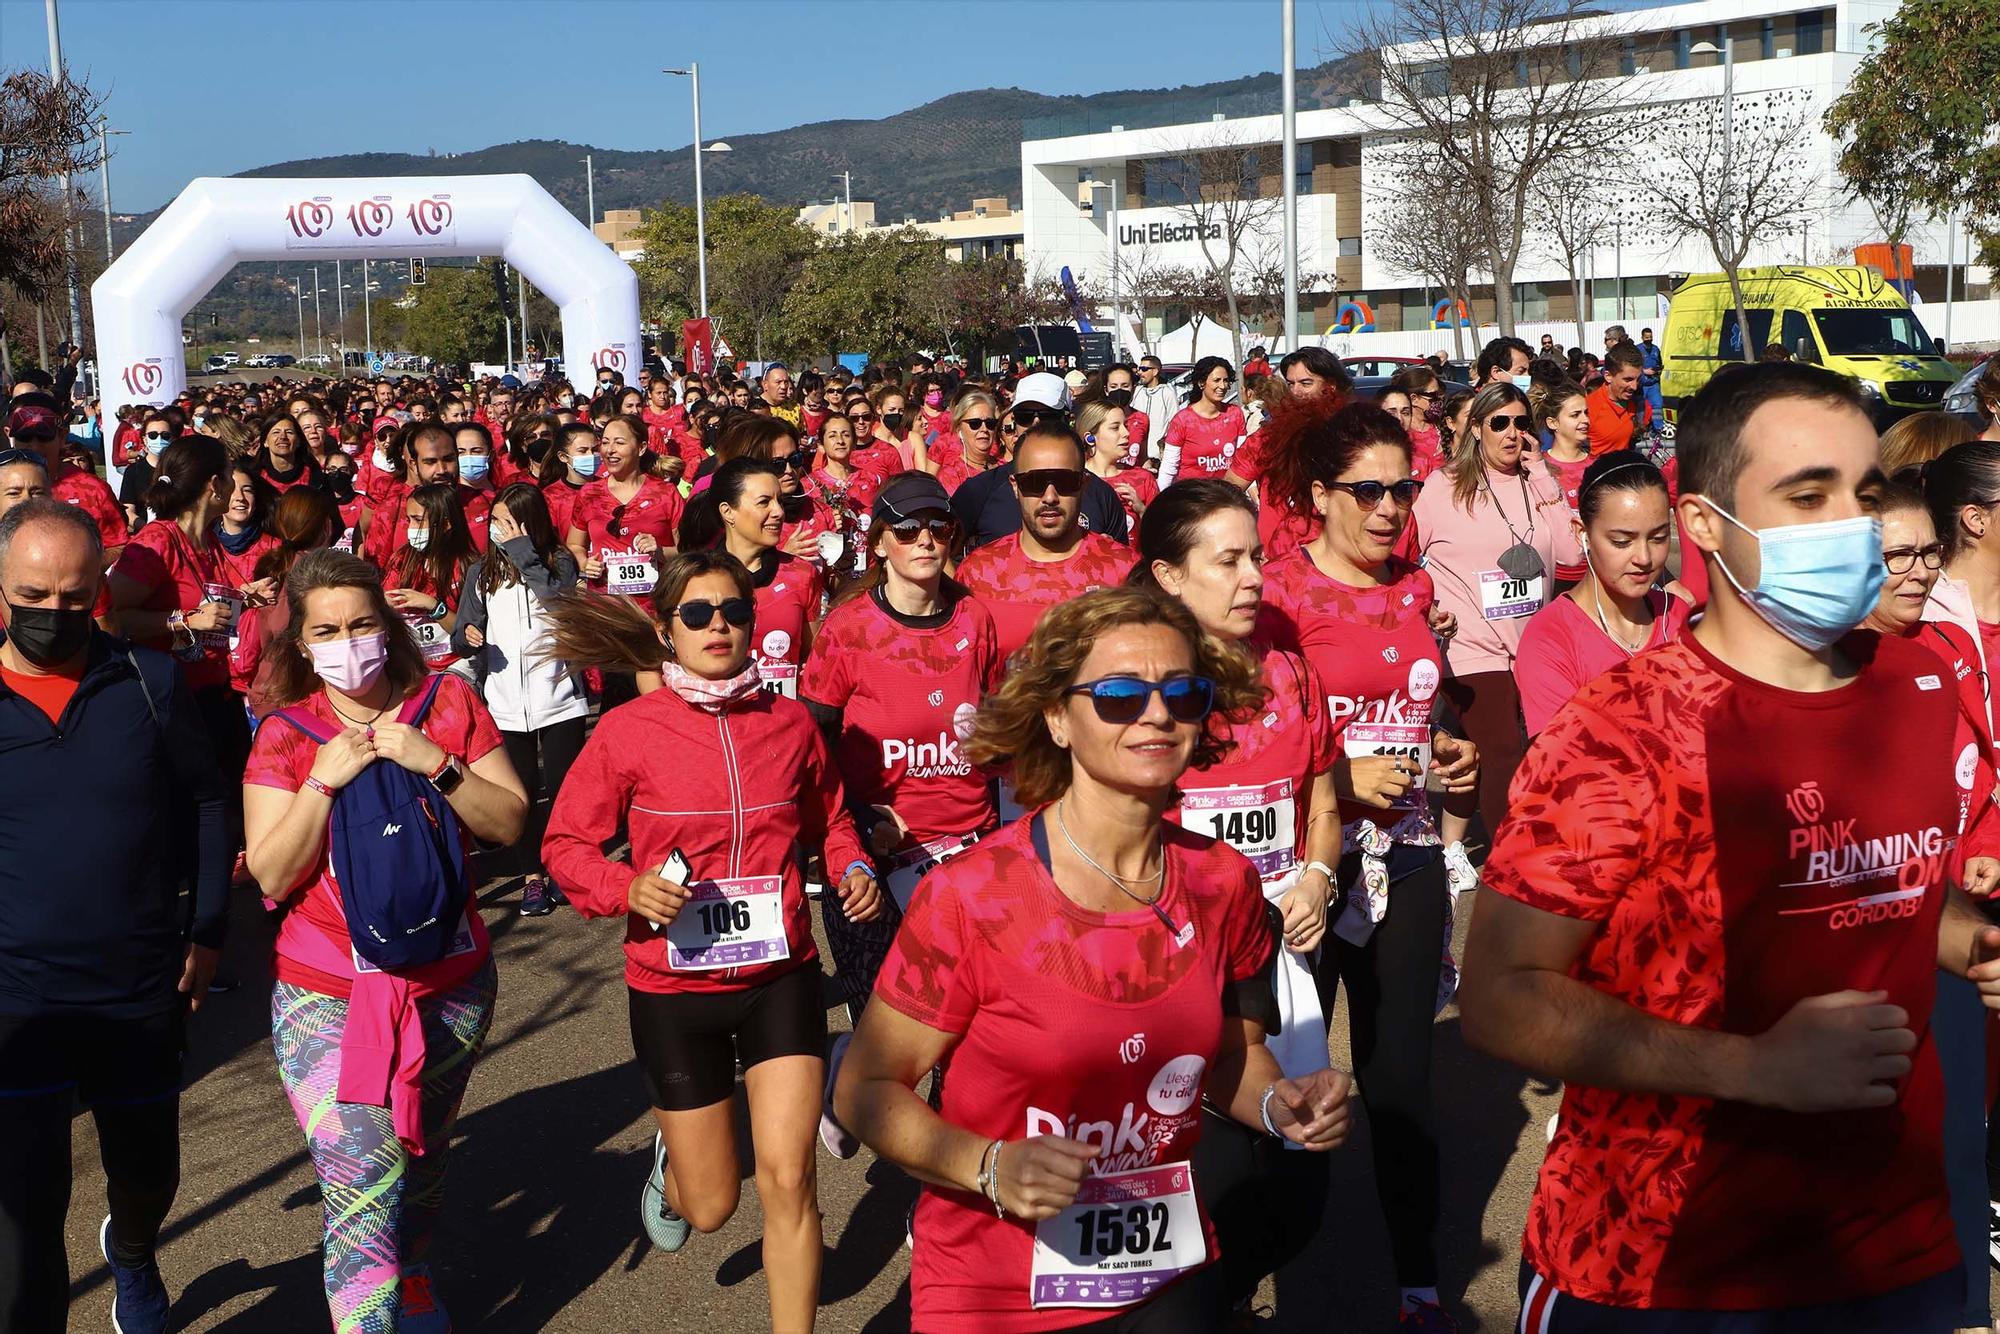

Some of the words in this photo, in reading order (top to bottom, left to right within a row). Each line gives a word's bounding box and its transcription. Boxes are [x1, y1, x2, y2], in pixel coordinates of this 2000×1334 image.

[1120, 224, 1145, 246] Uni
[1197, 453, 1226, 466] Pink
[619, 564, 645, 580] 393
[1501, 580, 1528, 599] 270
[1328, 688, 1408, 725] Pink
[882, 731, 959, 769] Pink
[905, 763, 972, 779] RUNNING
[1209, 806, 1277, 845] 1490
[1790, 818, 1856, 860] PINK
[1806, 826, 1943, 882] RUNNING
[1898, 848, 1947, 892] ON
[697, 900, 751, 935] 106
[1829, 896, 1923, 930] CÓRDOB
[1159, 1088, 1172, 1099] tu
[1132, 1188, 1149, 1198] MAR
[1075, 1202, 1172, 1256] 1532
[1097, 1262, 1110, 1270] MAY
[1112, 1261, 1129, 1269] SACO
[1130, 1259, 1153, 1268] TORRES
